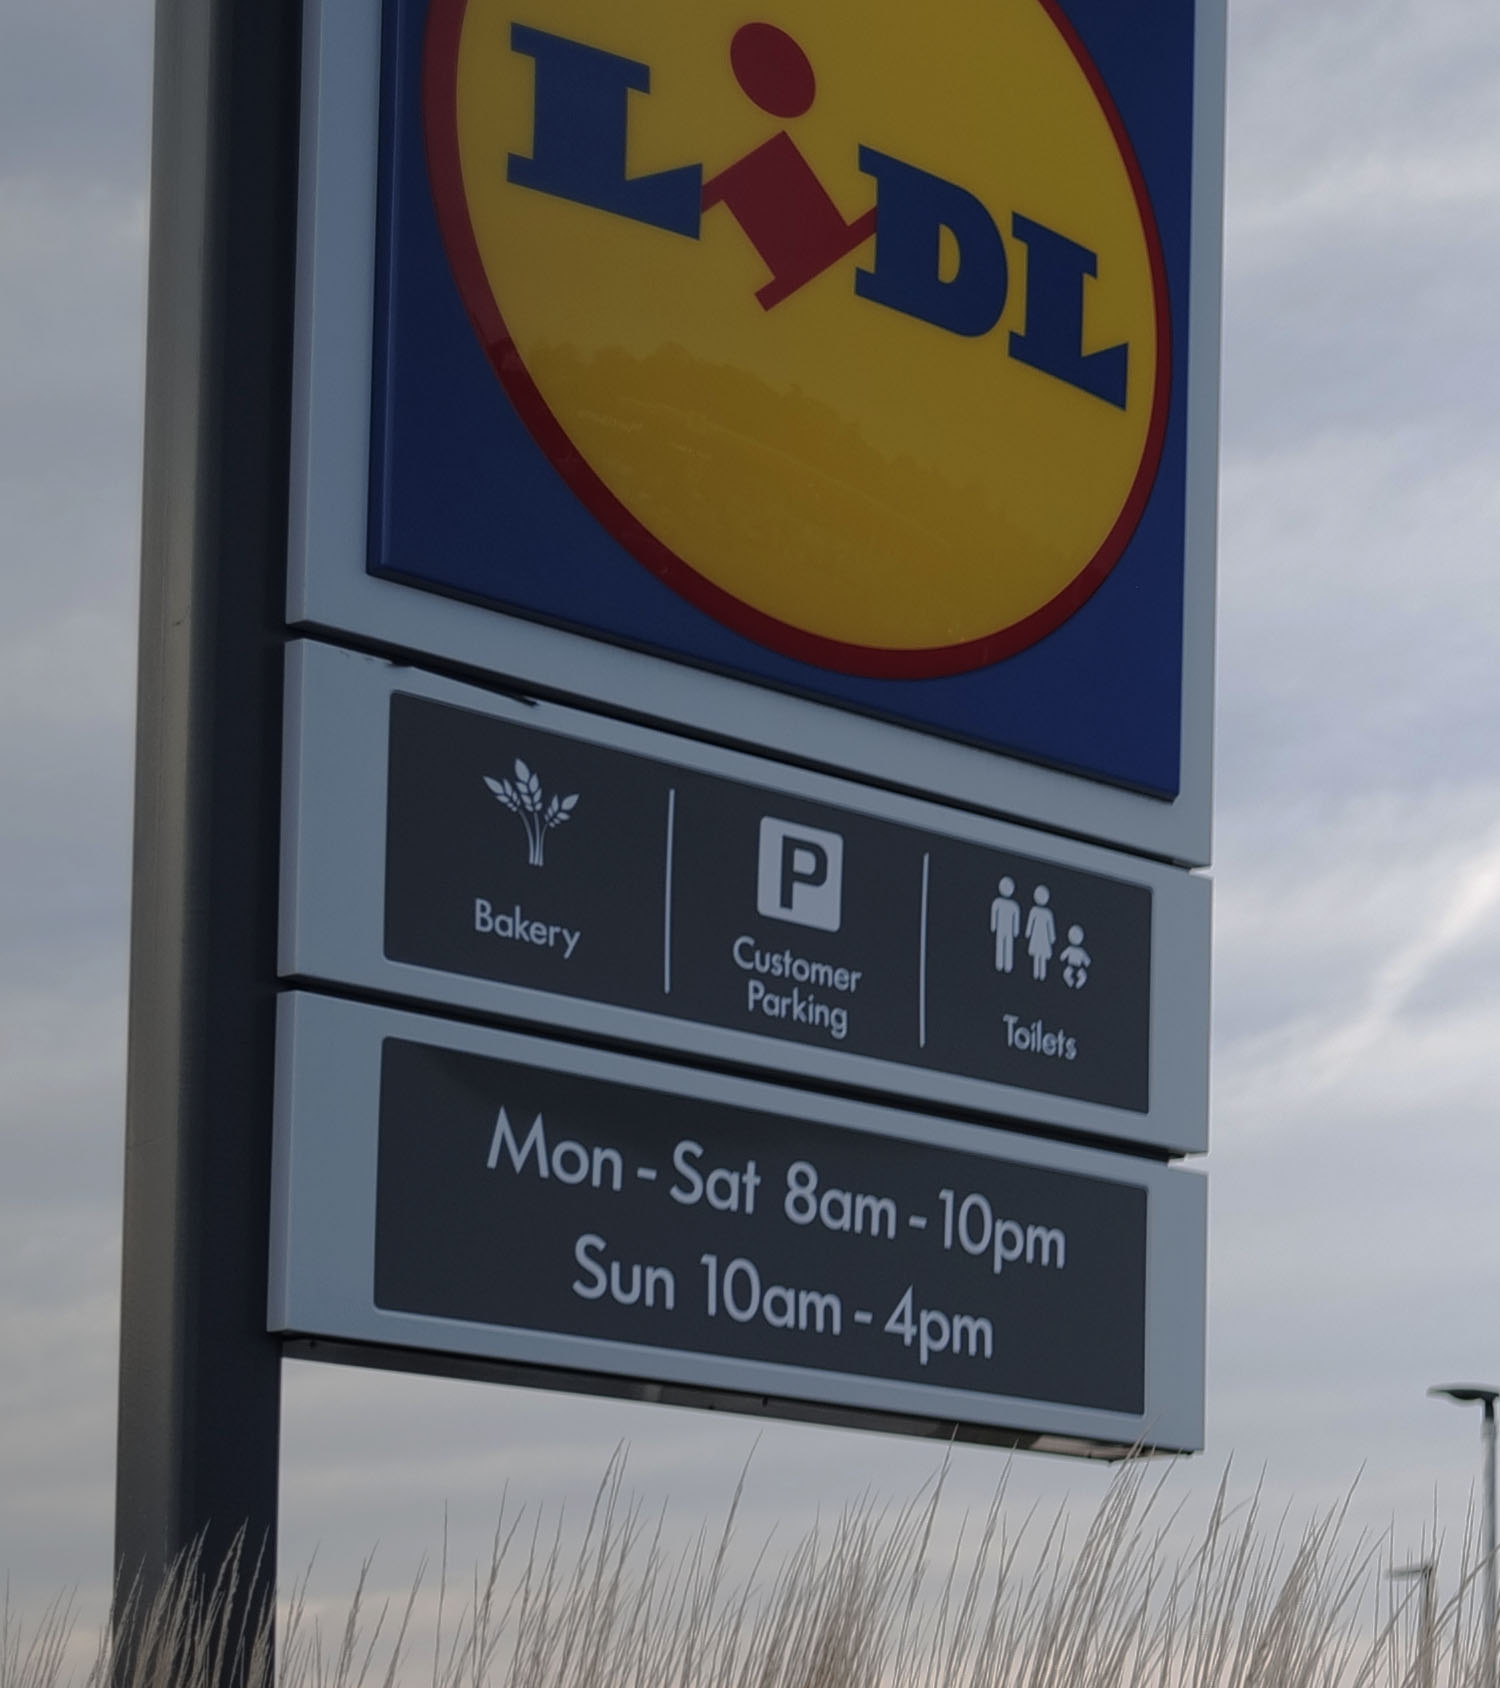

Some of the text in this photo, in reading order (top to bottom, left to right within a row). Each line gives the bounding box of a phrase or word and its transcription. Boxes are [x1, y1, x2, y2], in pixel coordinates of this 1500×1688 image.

[475, 899, 581, 960] Bakery
[732, 936, 862, 994] Customer
[748, 983, 849, 1040] Parking
[1002, 1014, 1078, 1060] Toilets
[572, 1234, 675, 1311] Sun
